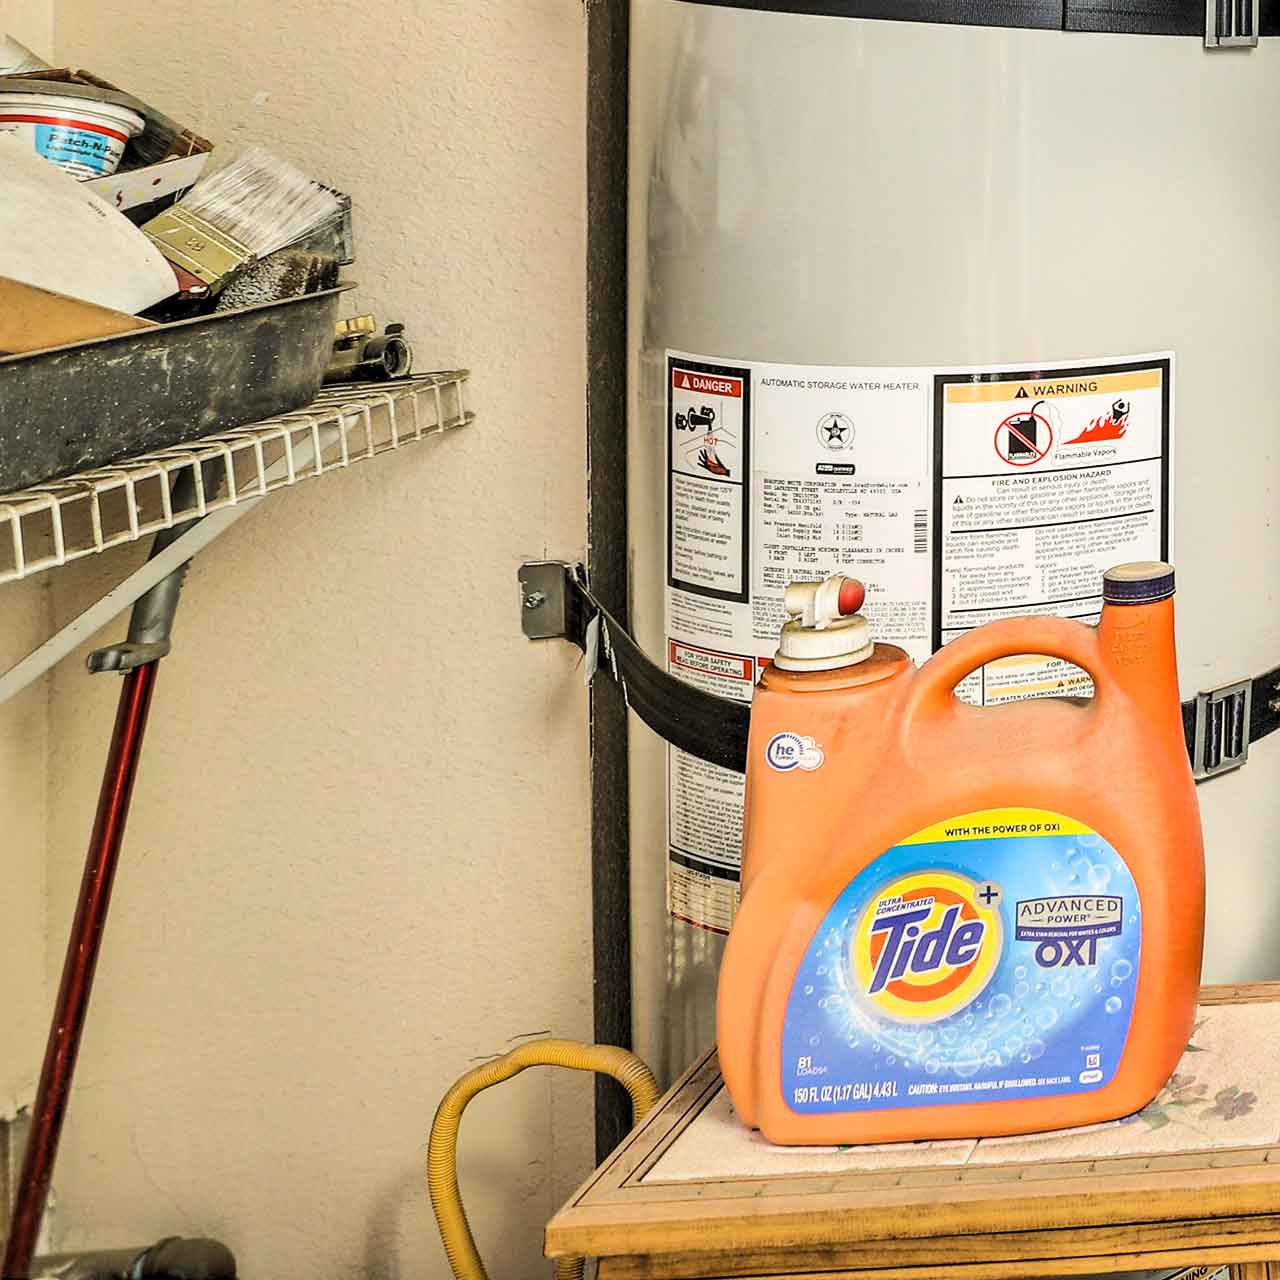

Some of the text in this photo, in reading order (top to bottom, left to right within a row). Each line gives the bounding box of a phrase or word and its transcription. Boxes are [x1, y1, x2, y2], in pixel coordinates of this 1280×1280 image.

[693, 378, 732, 393] DANGER
[761, 379, 805, 388] AUTOMATIC
[807, 381, 847, 389] STORAGE
[1034, 382, 1098, 395] WARNING
[704, 436, 717, 445] HOT
[1055, 448, 1117, 460] Flammable Vapors
[1033, 474, 1077, 483] EXPLOSION
[1080, 470, 1111, 479] HAZARD
[776, 744, 794, 755] he
[945, 828, 969, 836] WITH
[993, 825, 1026, 833] POWER
[877, 898, 933, 914] CONCENTRATED
[879, 897, 901, 906] ULTRA
[1021, 900, 1117, 916] ADVANCED
[868, 906, 985, 994] Tide
[1035, 938, 1096, 967] OXI
[798, 1057, 811, 1068] 81
[794, 1081, 897, 1104] 150 FL OZ (1.17 GAL) 4.43 L
